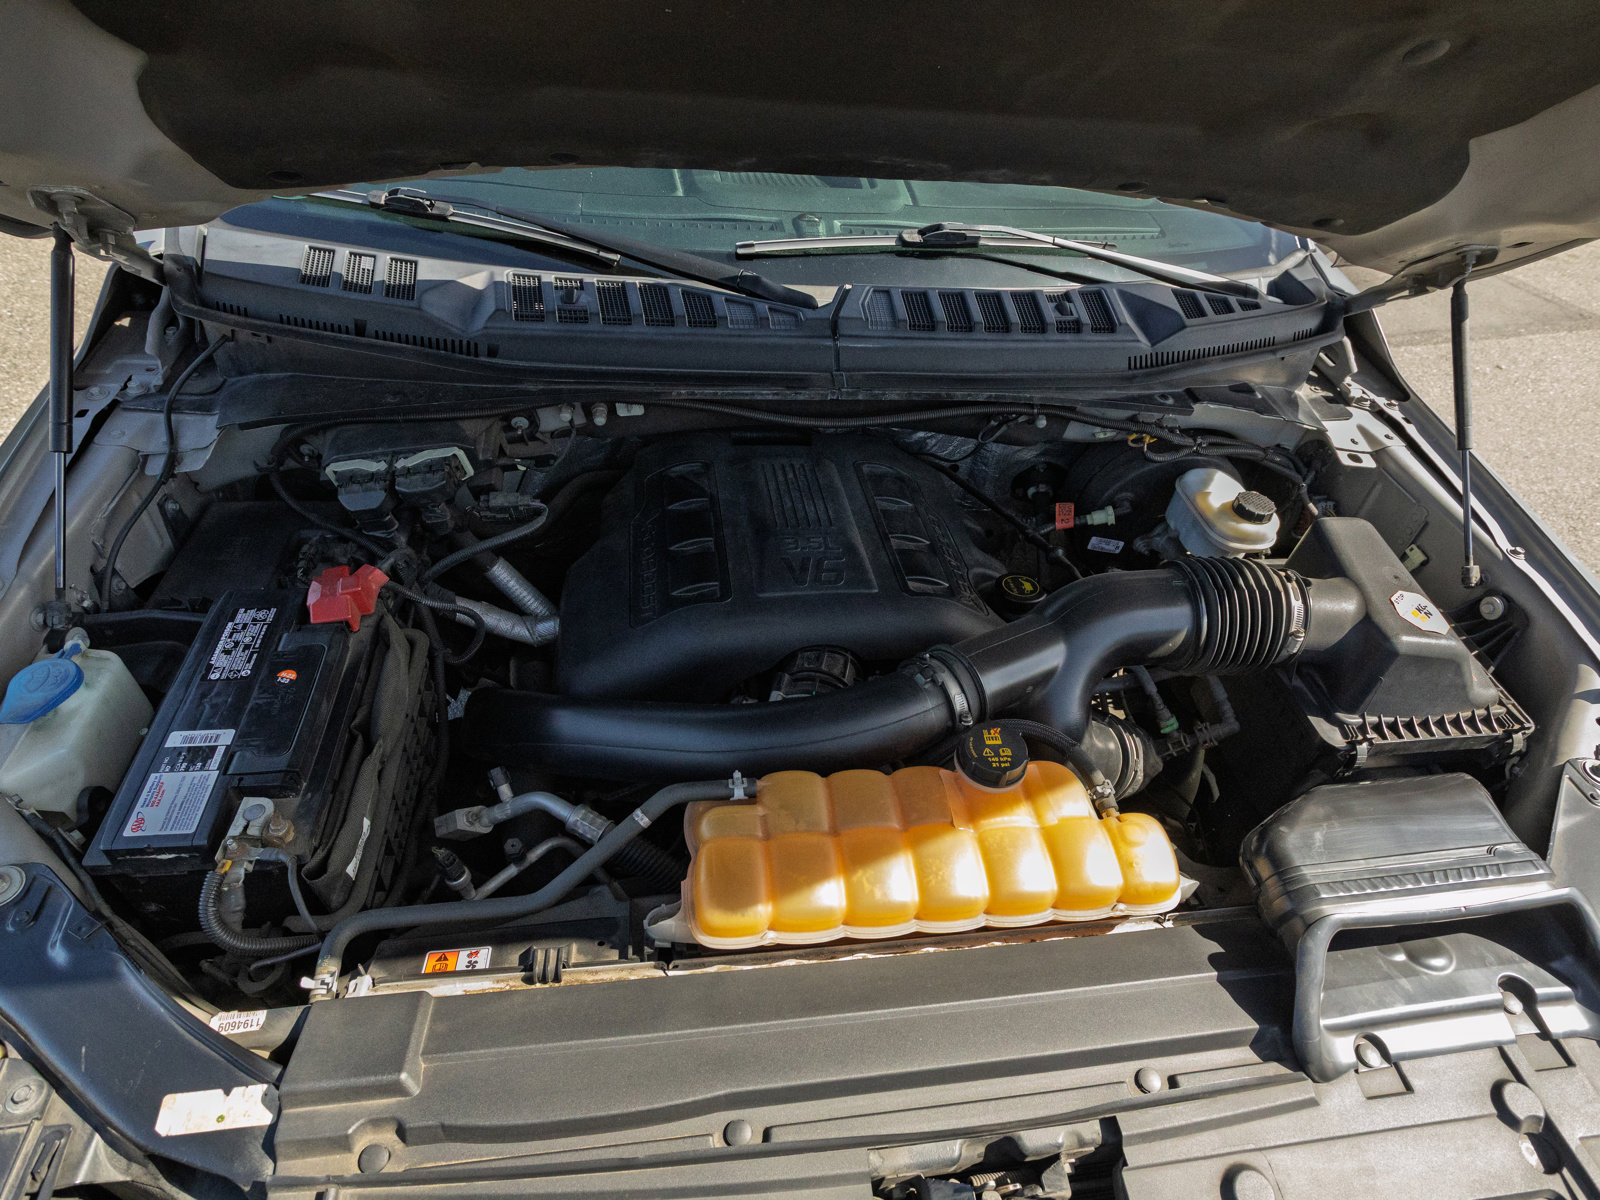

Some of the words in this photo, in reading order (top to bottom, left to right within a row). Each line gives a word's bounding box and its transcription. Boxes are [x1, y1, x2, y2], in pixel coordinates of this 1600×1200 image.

[780, 555, 847, 588] V6
[131, 818, 144, 833] AAA
[217, 1017, 262, 1033] 1194609
